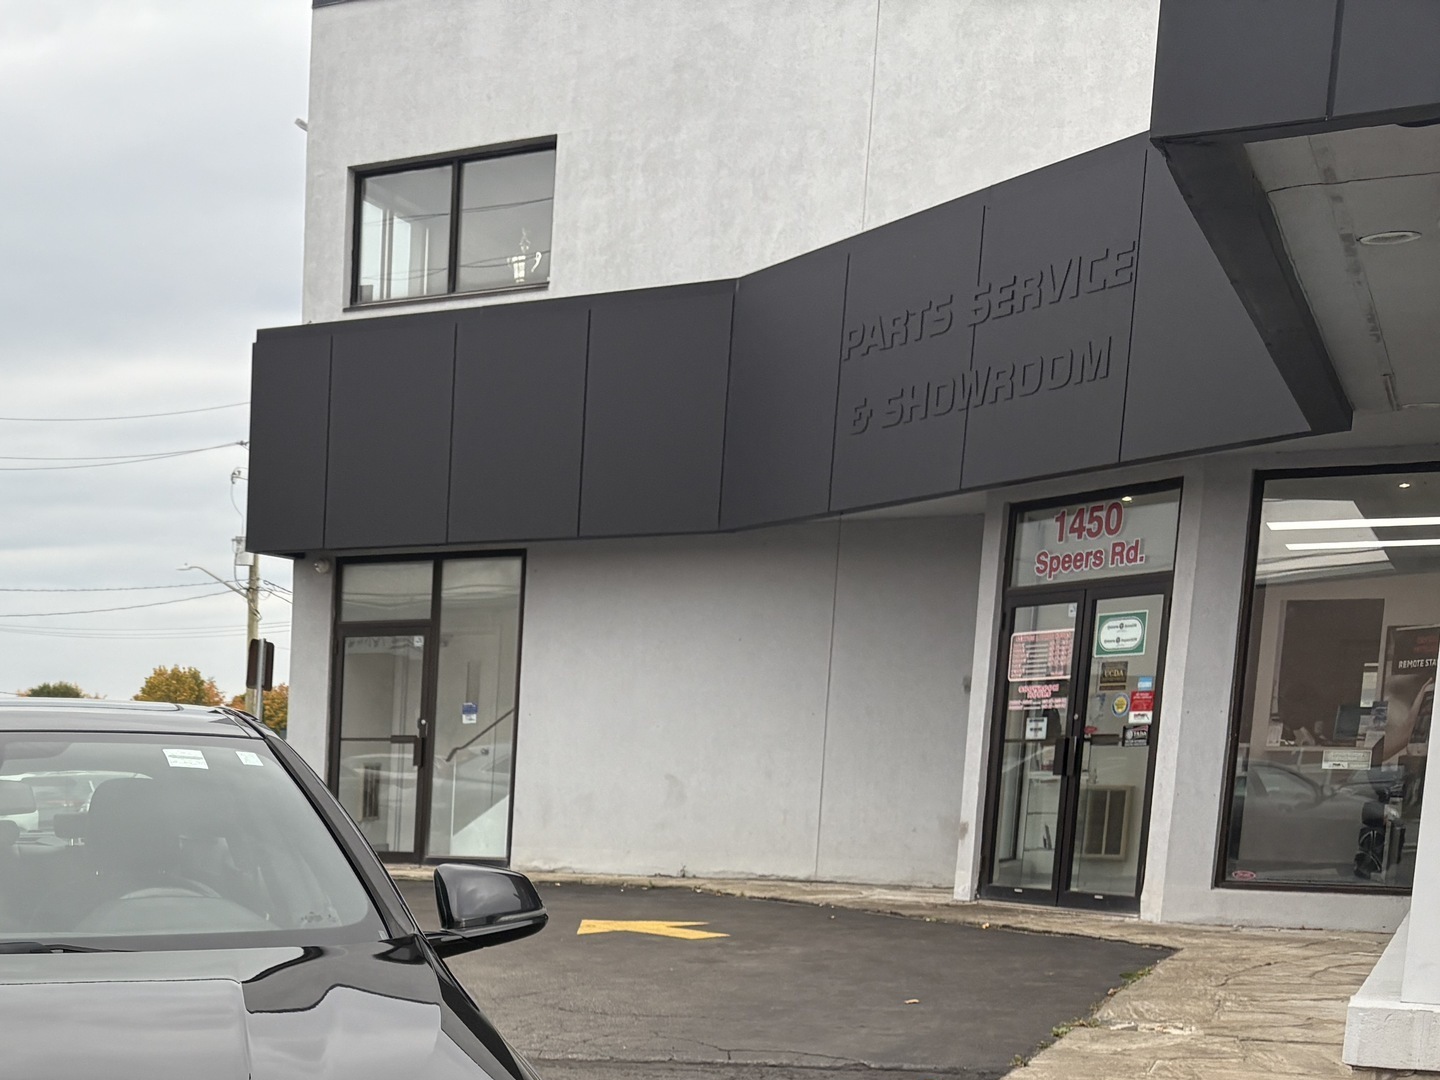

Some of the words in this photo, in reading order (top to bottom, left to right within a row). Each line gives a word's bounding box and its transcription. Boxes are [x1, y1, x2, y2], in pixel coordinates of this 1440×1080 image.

[843, 294, 954, 362] PARTS
[967, 240, 1137, 328] SERVICE
[850, 397, 874, 436] &
[881, 335, 1113, 429] SHOWROOM
[1055, 501, 1124, 544] 1450
[1034, 549, 1105, 581] Speers
[1109, 537, 1146, 568] Rd.
